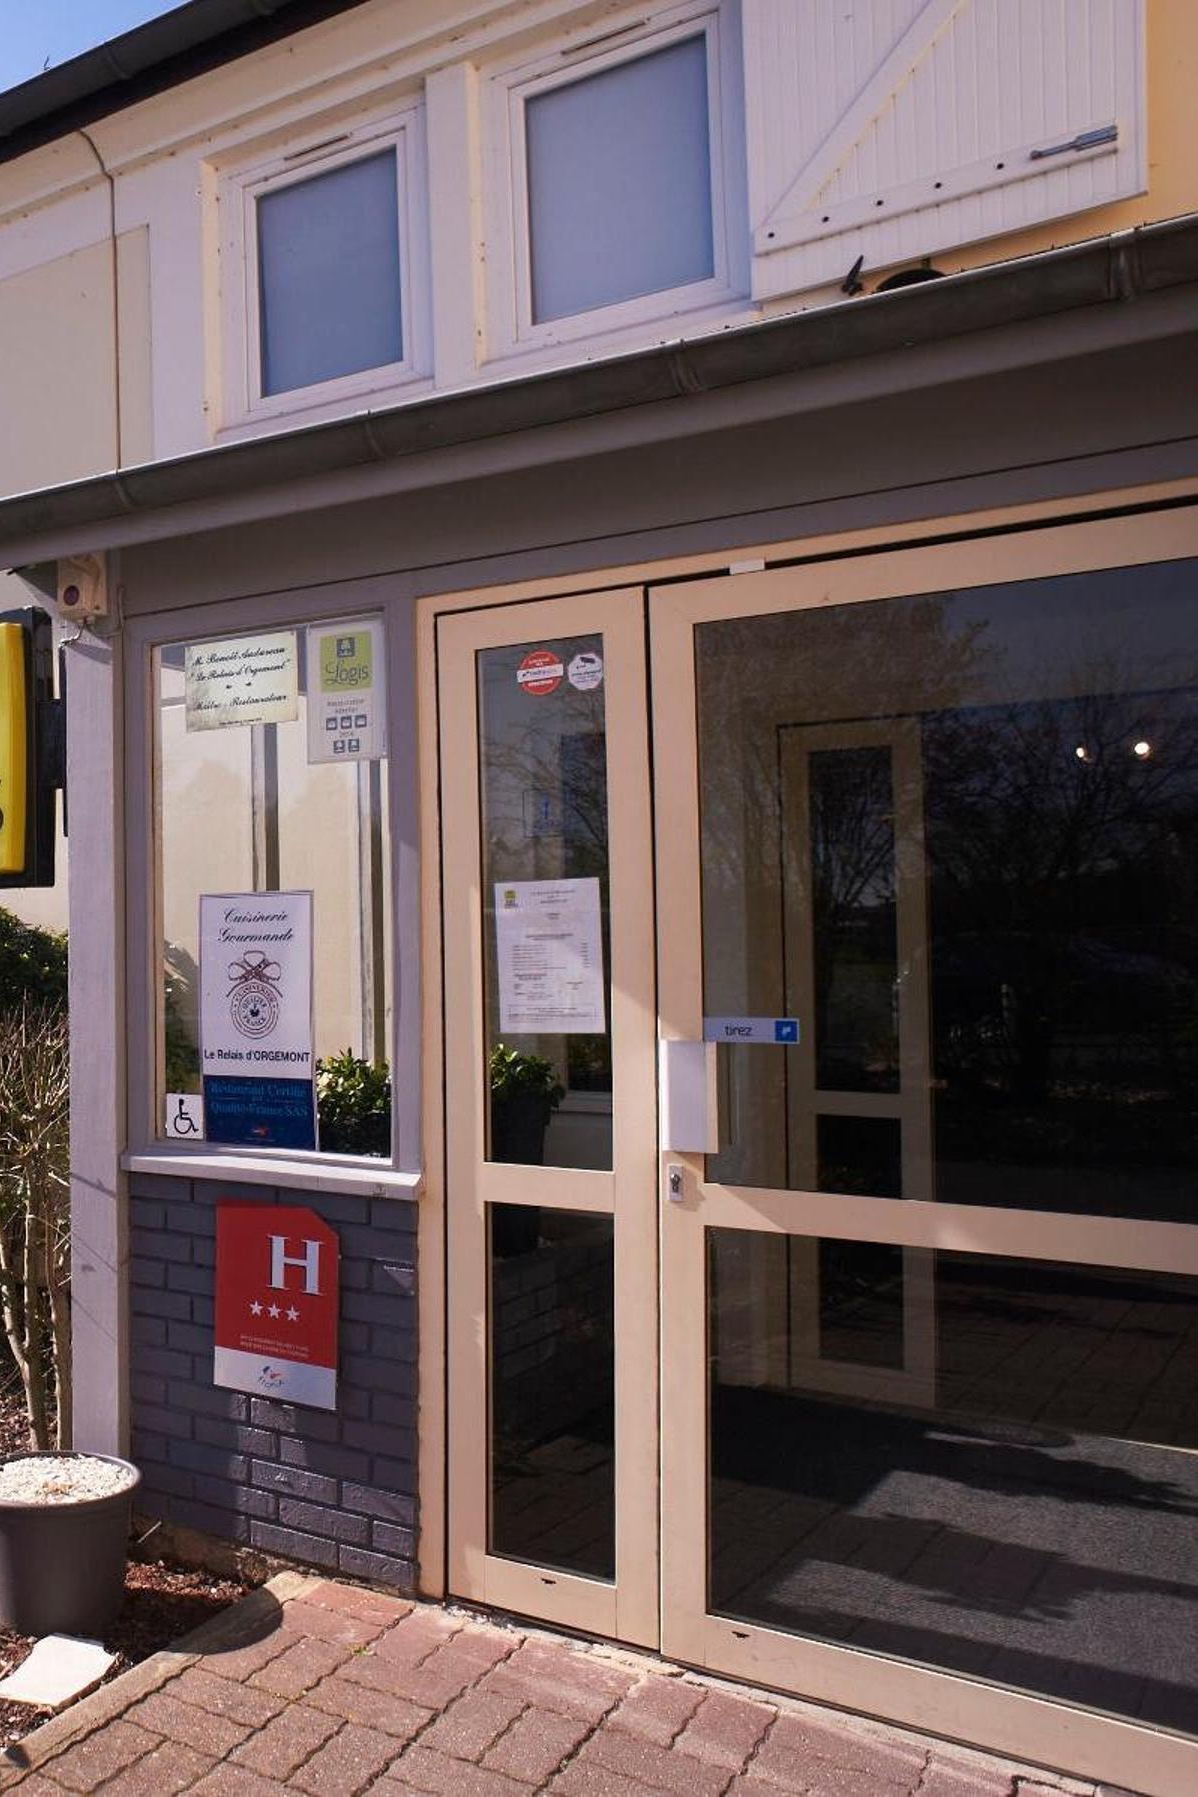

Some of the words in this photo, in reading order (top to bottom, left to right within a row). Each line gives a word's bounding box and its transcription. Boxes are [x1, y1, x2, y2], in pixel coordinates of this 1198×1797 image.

[323, 659, 369, 686] Logis
[223, 908, 289, 923] Cuisinerie
[217, 927, 293, 942] Gourmande
[724, 1025, 753, 1037] tirez
[204, 1048, 215, 1060] Le
[217, 1049, 244, 1060] Relais
[246, 1050, 310, 1062] d'ORGEMONT
[266, 1234, 324, 1297] H
